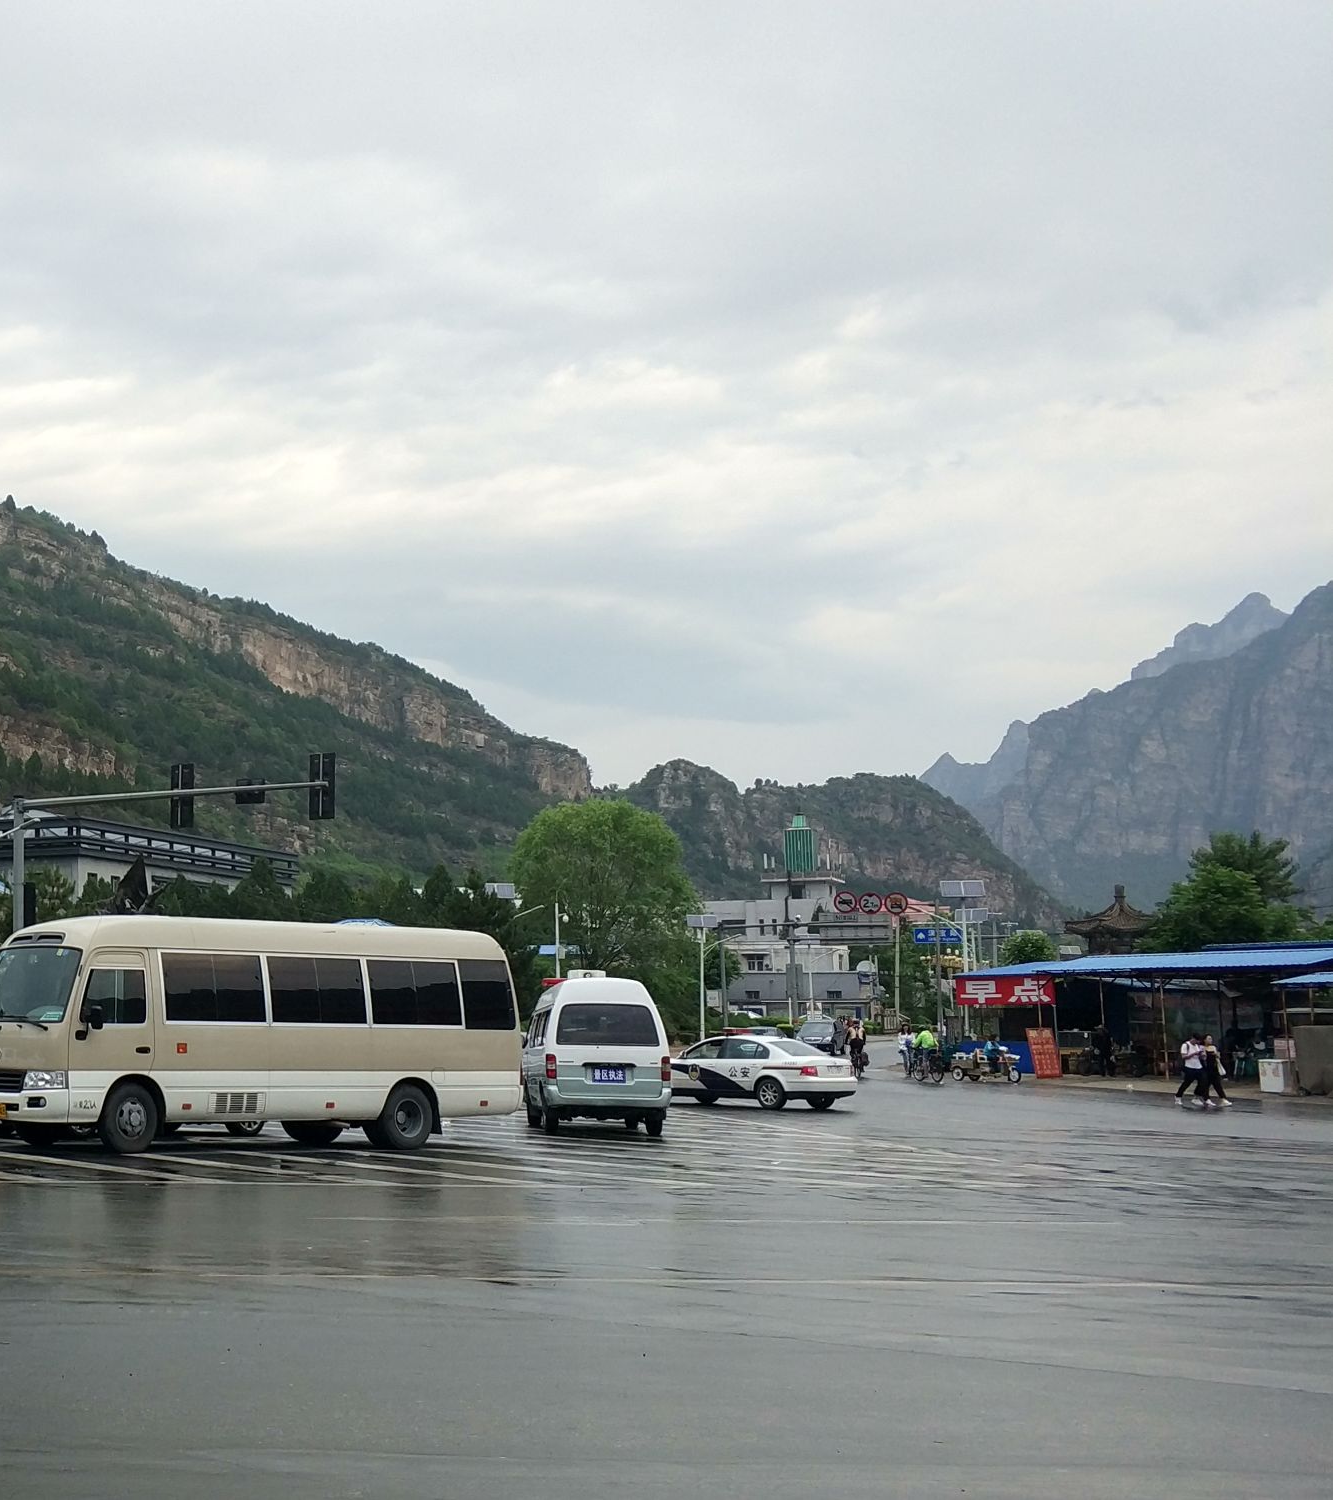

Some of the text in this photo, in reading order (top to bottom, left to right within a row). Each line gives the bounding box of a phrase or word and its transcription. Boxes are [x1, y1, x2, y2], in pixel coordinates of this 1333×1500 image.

[960, 978, 1052, 1004] 早点
[593, 1068, 624, 1081] 景区执法
[728, 1066, 751, 1078] 公安
